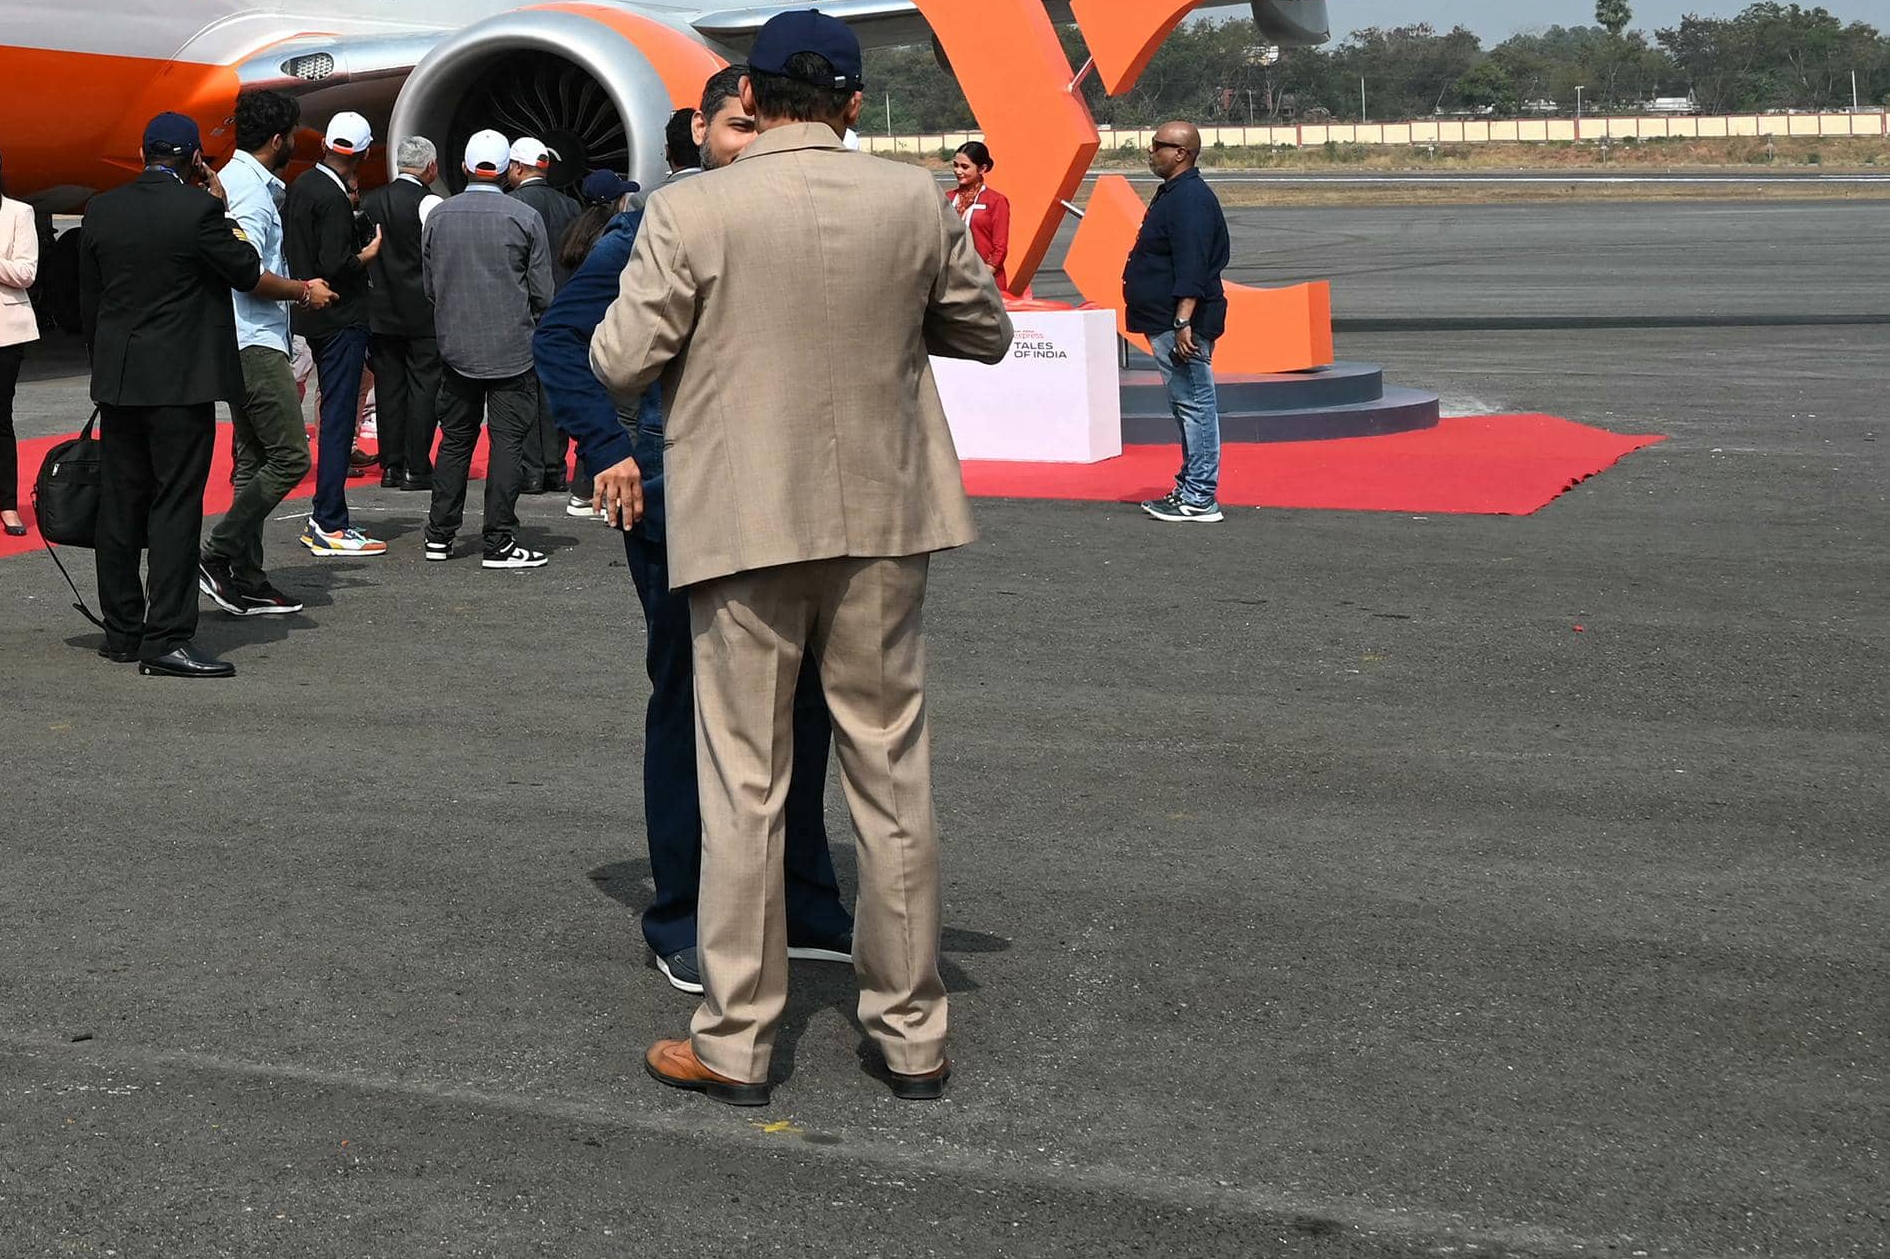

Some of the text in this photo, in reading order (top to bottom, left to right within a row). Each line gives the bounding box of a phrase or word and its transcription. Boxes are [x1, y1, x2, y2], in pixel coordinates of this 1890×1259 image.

[1014, 341, 1054, 350] TALES
[1014, 350, 1067, 359] OF INDIA
